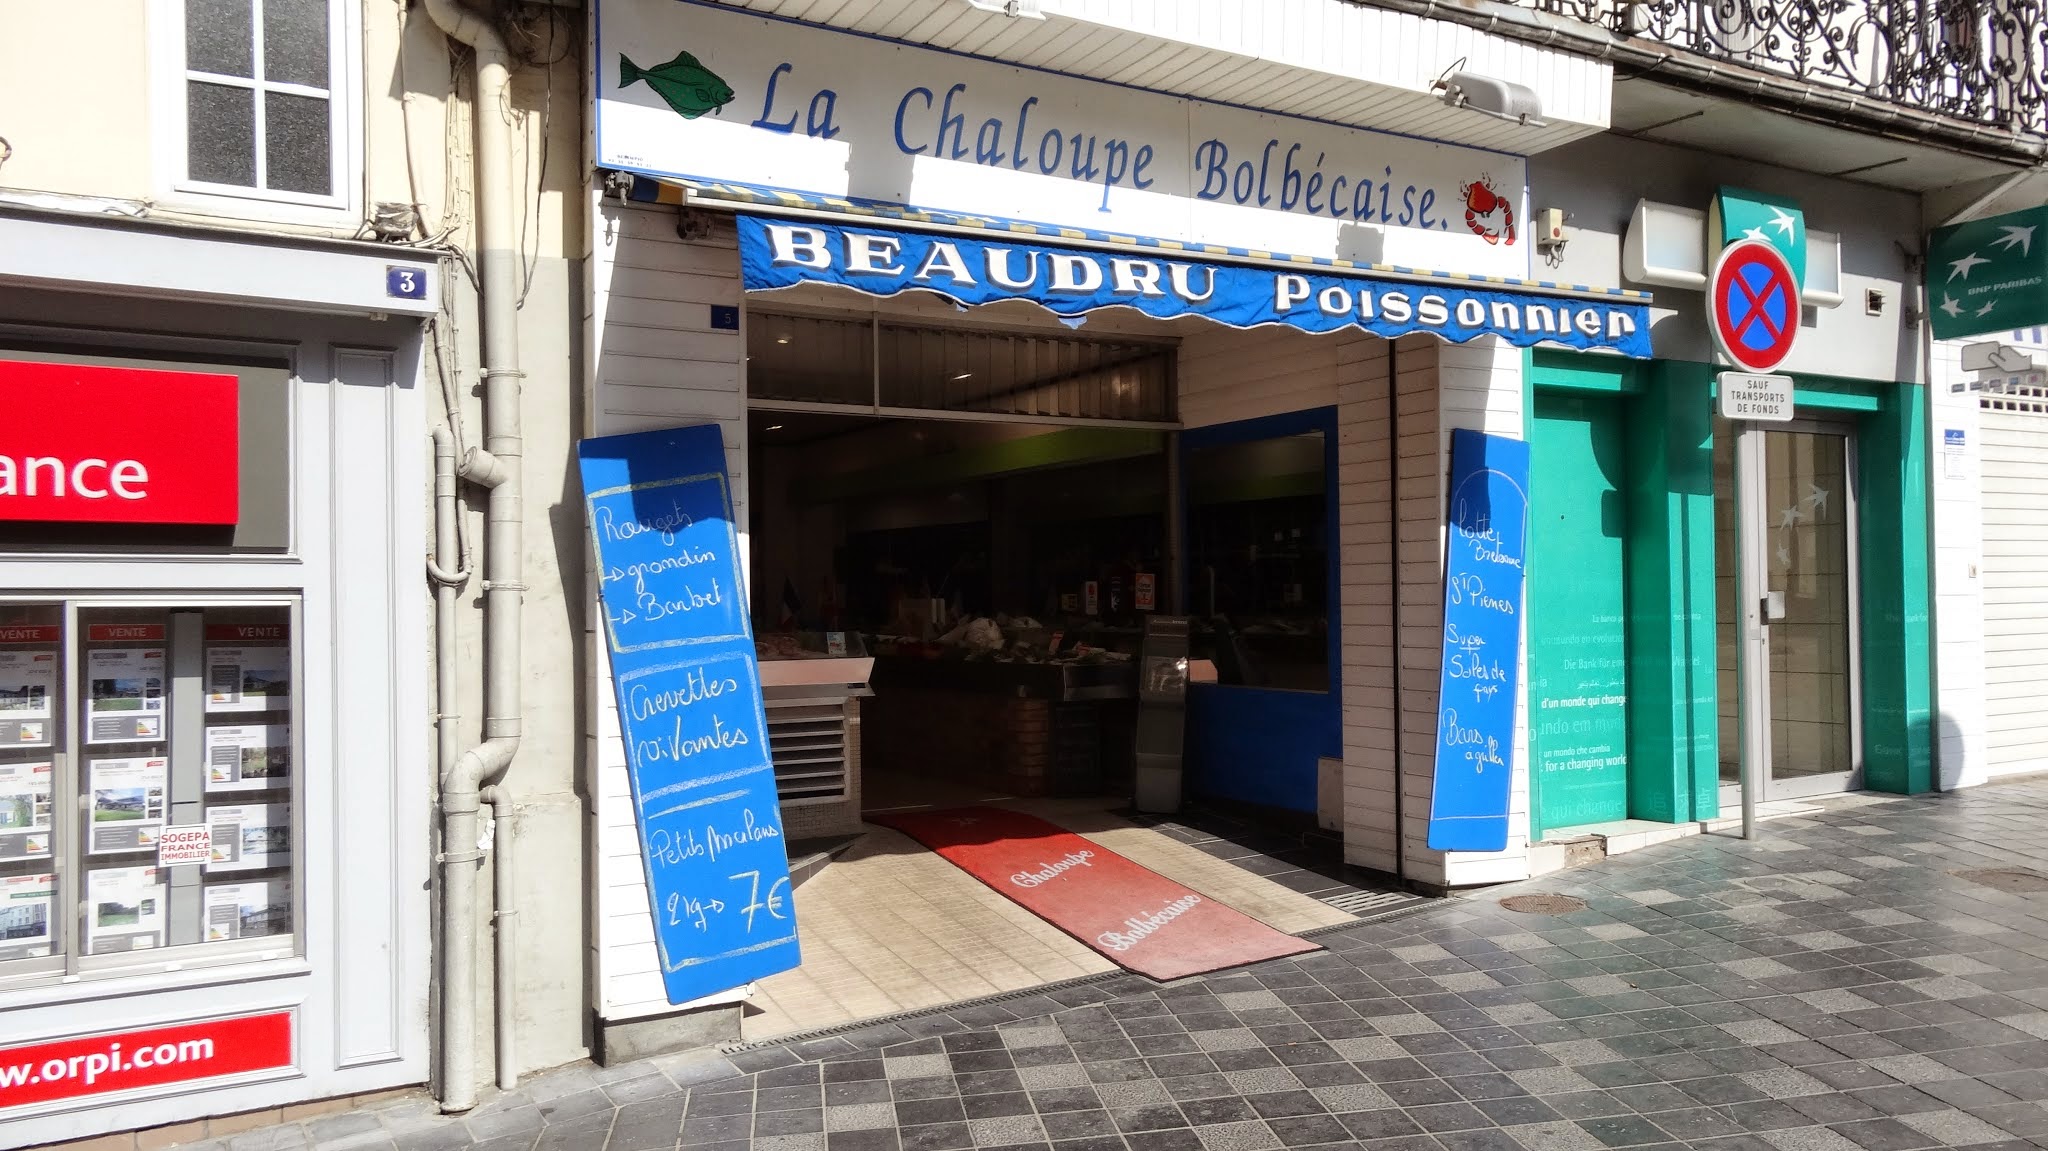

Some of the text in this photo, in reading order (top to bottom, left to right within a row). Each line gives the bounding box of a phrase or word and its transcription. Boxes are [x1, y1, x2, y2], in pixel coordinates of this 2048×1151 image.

[751, 62, 840, 140] La
[893, 83, 1154, 213] Chaloupe
[764, 224, 1219, 302] BEAUDRU
[400, 272, 415, 293] 3
[1967, 276, 2042, 296] BNP PARIBAS
[724, 313, 732, 324] 5
[1747, 380, 1769, 390] SAUF
[1731, 391, 1785, 402] TRANSPORTS
[1737, 403, 1779, 414] DE FONDS
[108, 627, 147, 638] VENTE
[238, 626, 281, 638] VENTE
[1560, 695, 1586, 707] monde
[1587, 694, 1600, 708] qui
[1553, 747, 1576, 757] mondo
[1545, 760, 1558, 772] for
[1559, 761, 1565, 770] a
[1566, 757, 1604, 771] changing
[161, 831, 210, 843] SOGEPA
[161, 842, 211, 852] FRANCE
[161, 850, 211, 861] IMMOBILIER
[1010, 849, 1096, 888] Chaloupe
